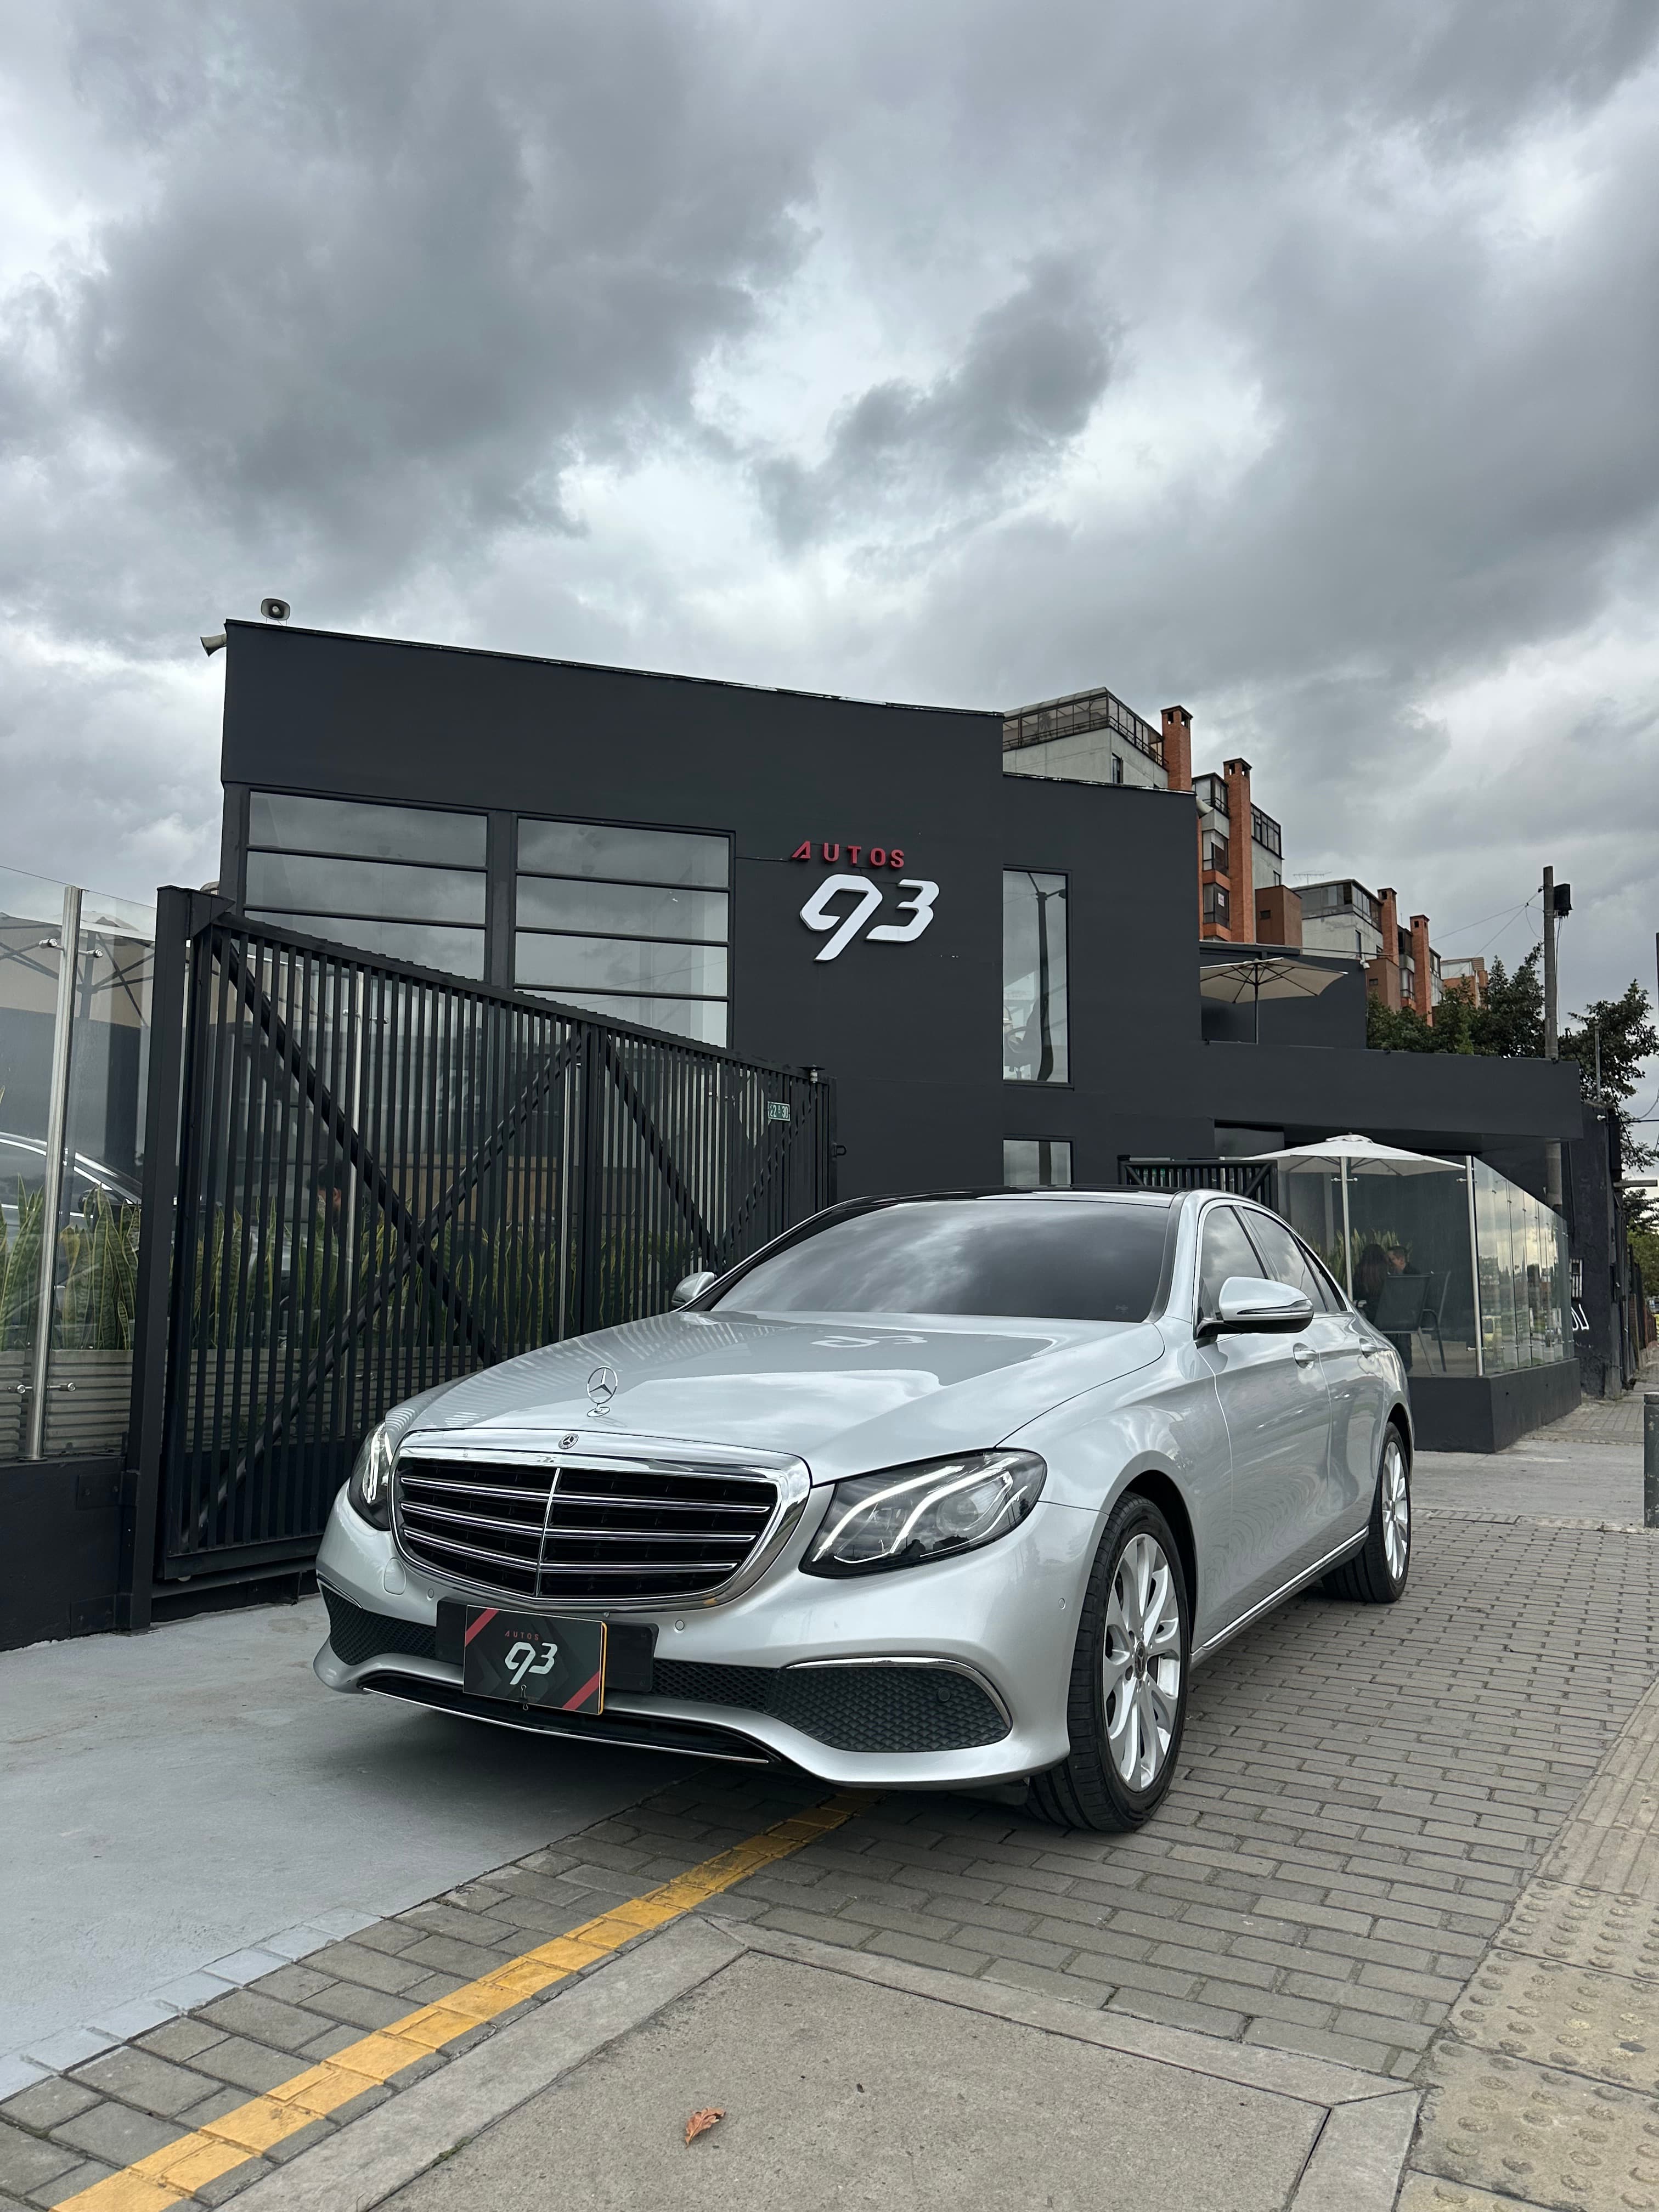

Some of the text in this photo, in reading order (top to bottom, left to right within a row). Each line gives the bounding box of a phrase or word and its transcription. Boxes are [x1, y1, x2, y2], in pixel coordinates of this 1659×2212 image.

[792, 840, 904, 868] AUTOS
[799, 874, 939, 961] 93
[505, 1630, 539, 1640] AUTOS
[505, 1641, 558, 1685] 93
